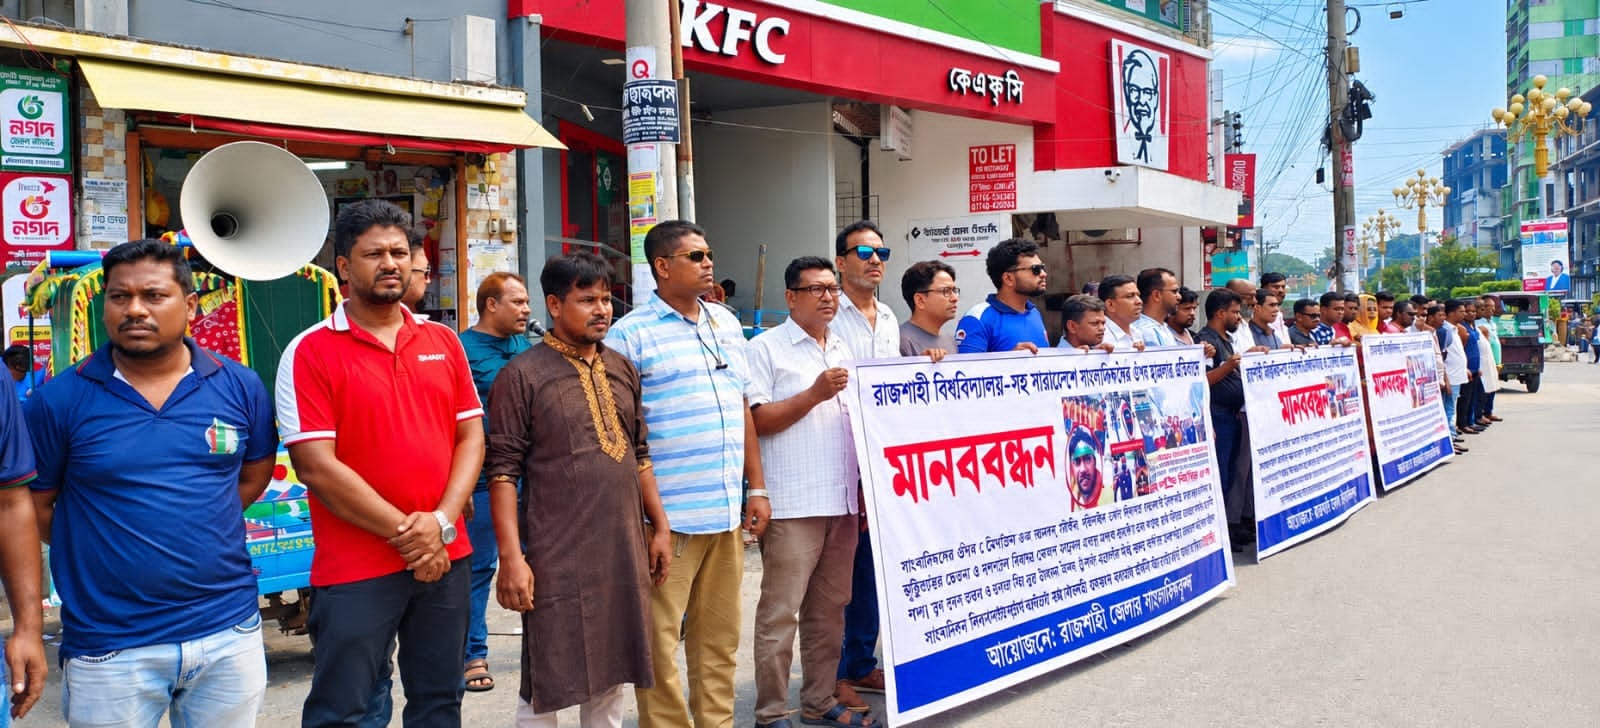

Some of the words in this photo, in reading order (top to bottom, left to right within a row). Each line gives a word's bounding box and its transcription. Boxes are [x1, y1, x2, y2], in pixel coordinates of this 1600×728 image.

[681, 0, 791, 64] KFC
[9, 120, 55, 138] নগদ
[971, 148, 988, 164] TO
[991, 146, 1014, 163] LET
[12, 221, 59, 236] নগদ
[872, 371, 930, 407] রাজশাহী
[883, 425, 1055, 503] মানববন্ধন
[985, 627, 1057, 668] আয়োজনে:
[1058, 603, 1108, 643] রাজশাহী
[1109, 596, 1143, 625] জেলার
